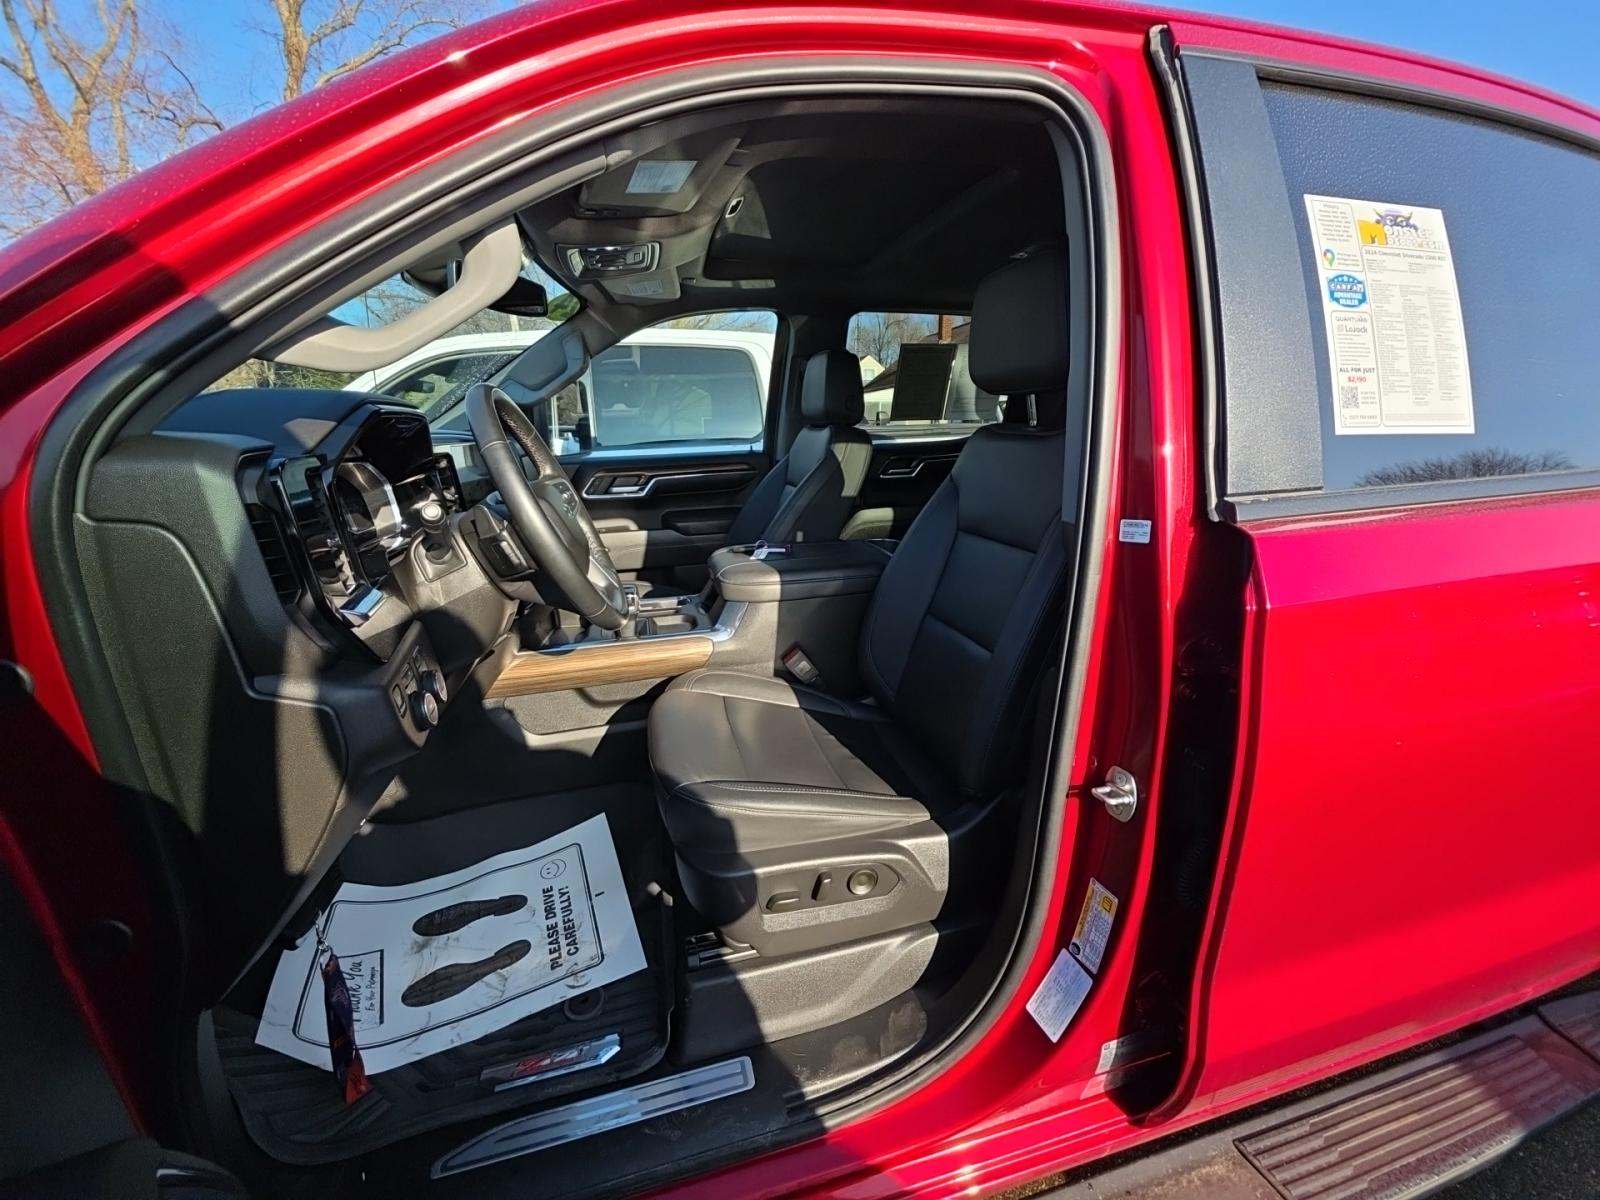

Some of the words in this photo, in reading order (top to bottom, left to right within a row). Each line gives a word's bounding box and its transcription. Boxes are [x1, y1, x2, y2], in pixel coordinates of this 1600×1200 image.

[542, 885, 557, 921] DRIVE
[558, 885, 580, 957] CAREFULLY!
[546, 921, 563, 972] PLEASE
[340, 959, 364, 981] You
